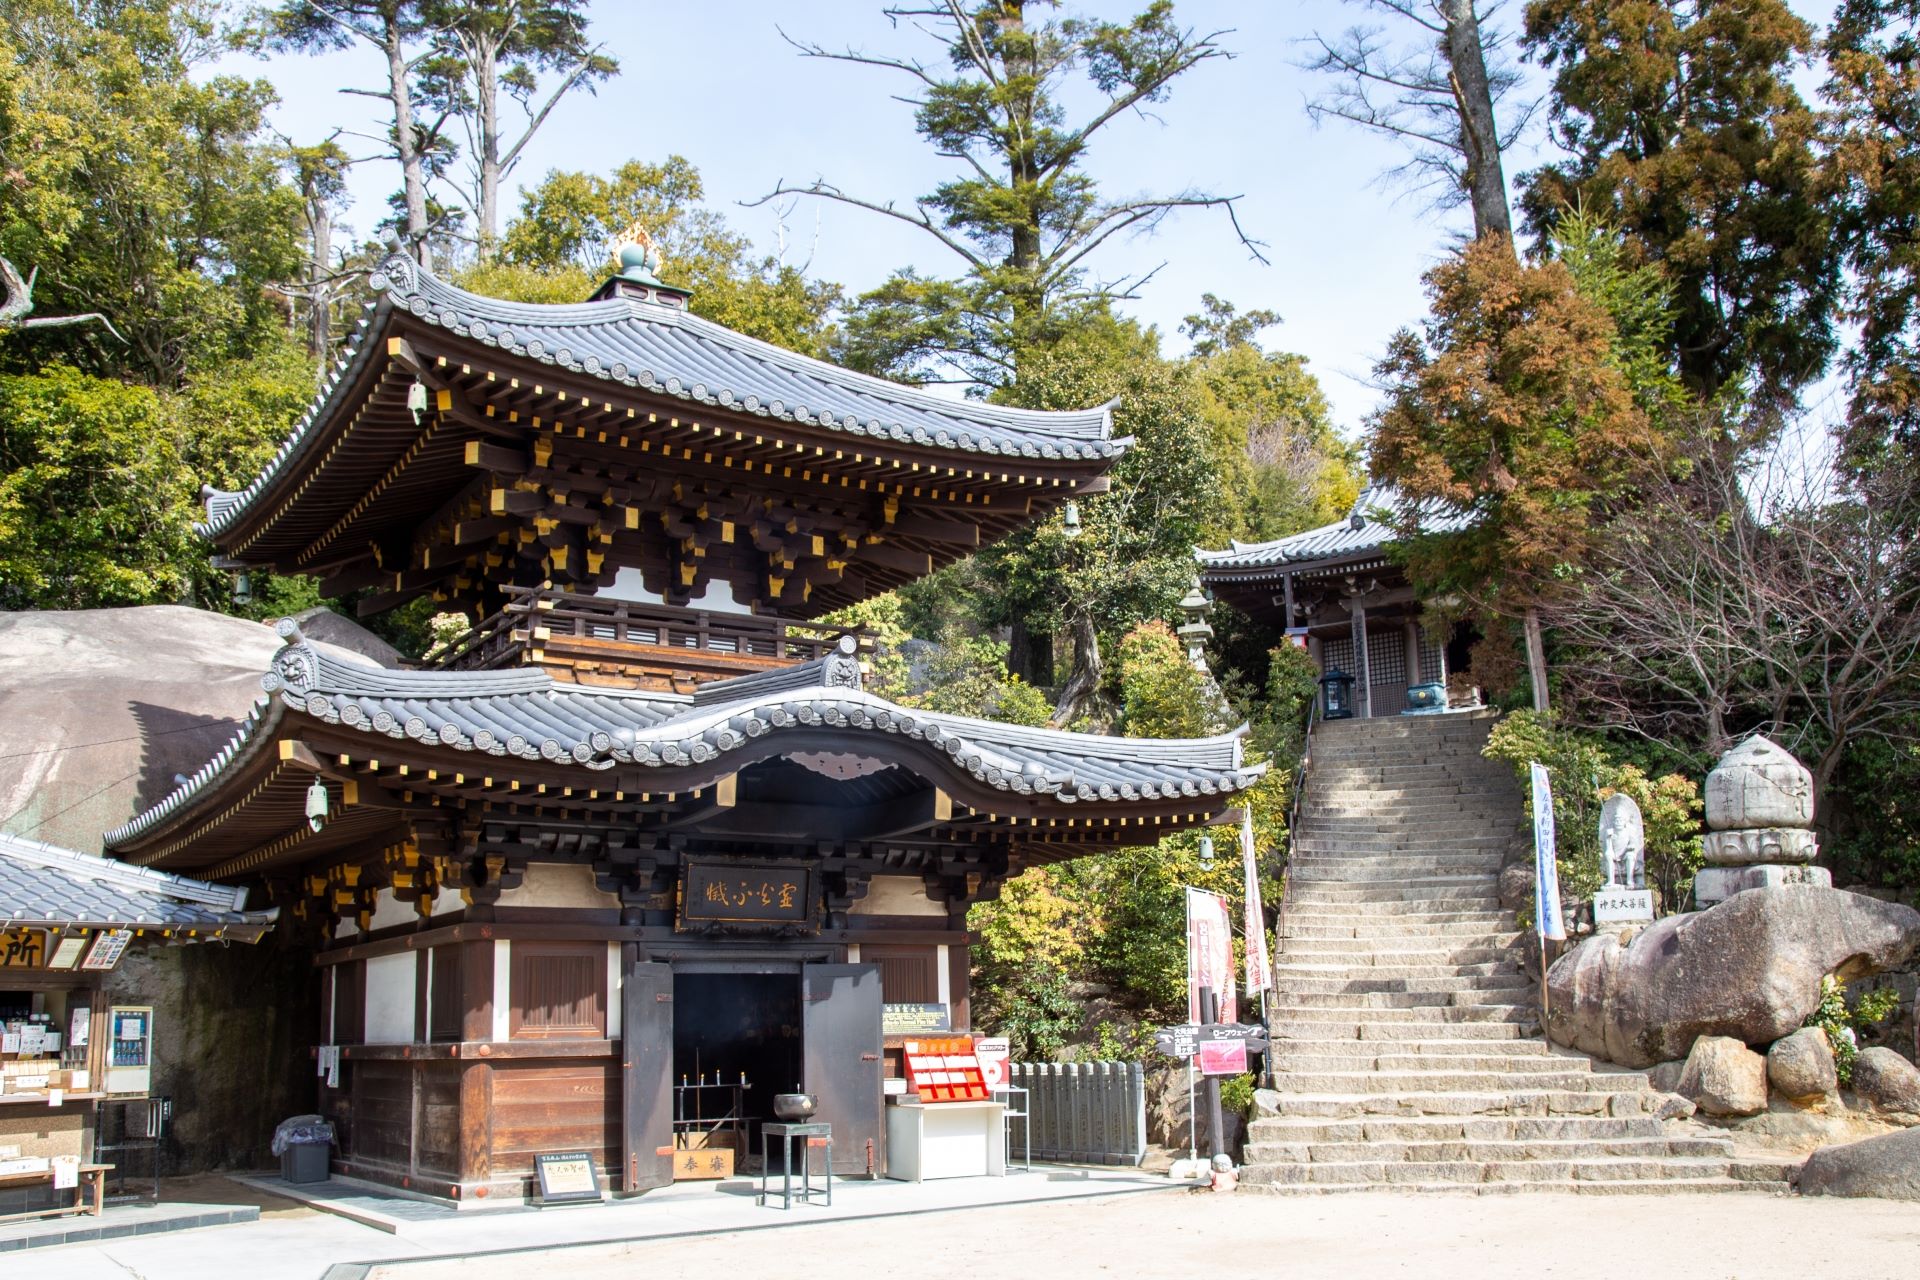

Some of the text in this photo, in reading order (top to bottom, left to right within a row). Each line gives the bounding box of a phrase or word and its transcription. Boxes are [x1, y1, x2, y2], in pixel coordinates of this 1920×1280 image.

[1213, 1029, 1248, 1037] ロープウェー
